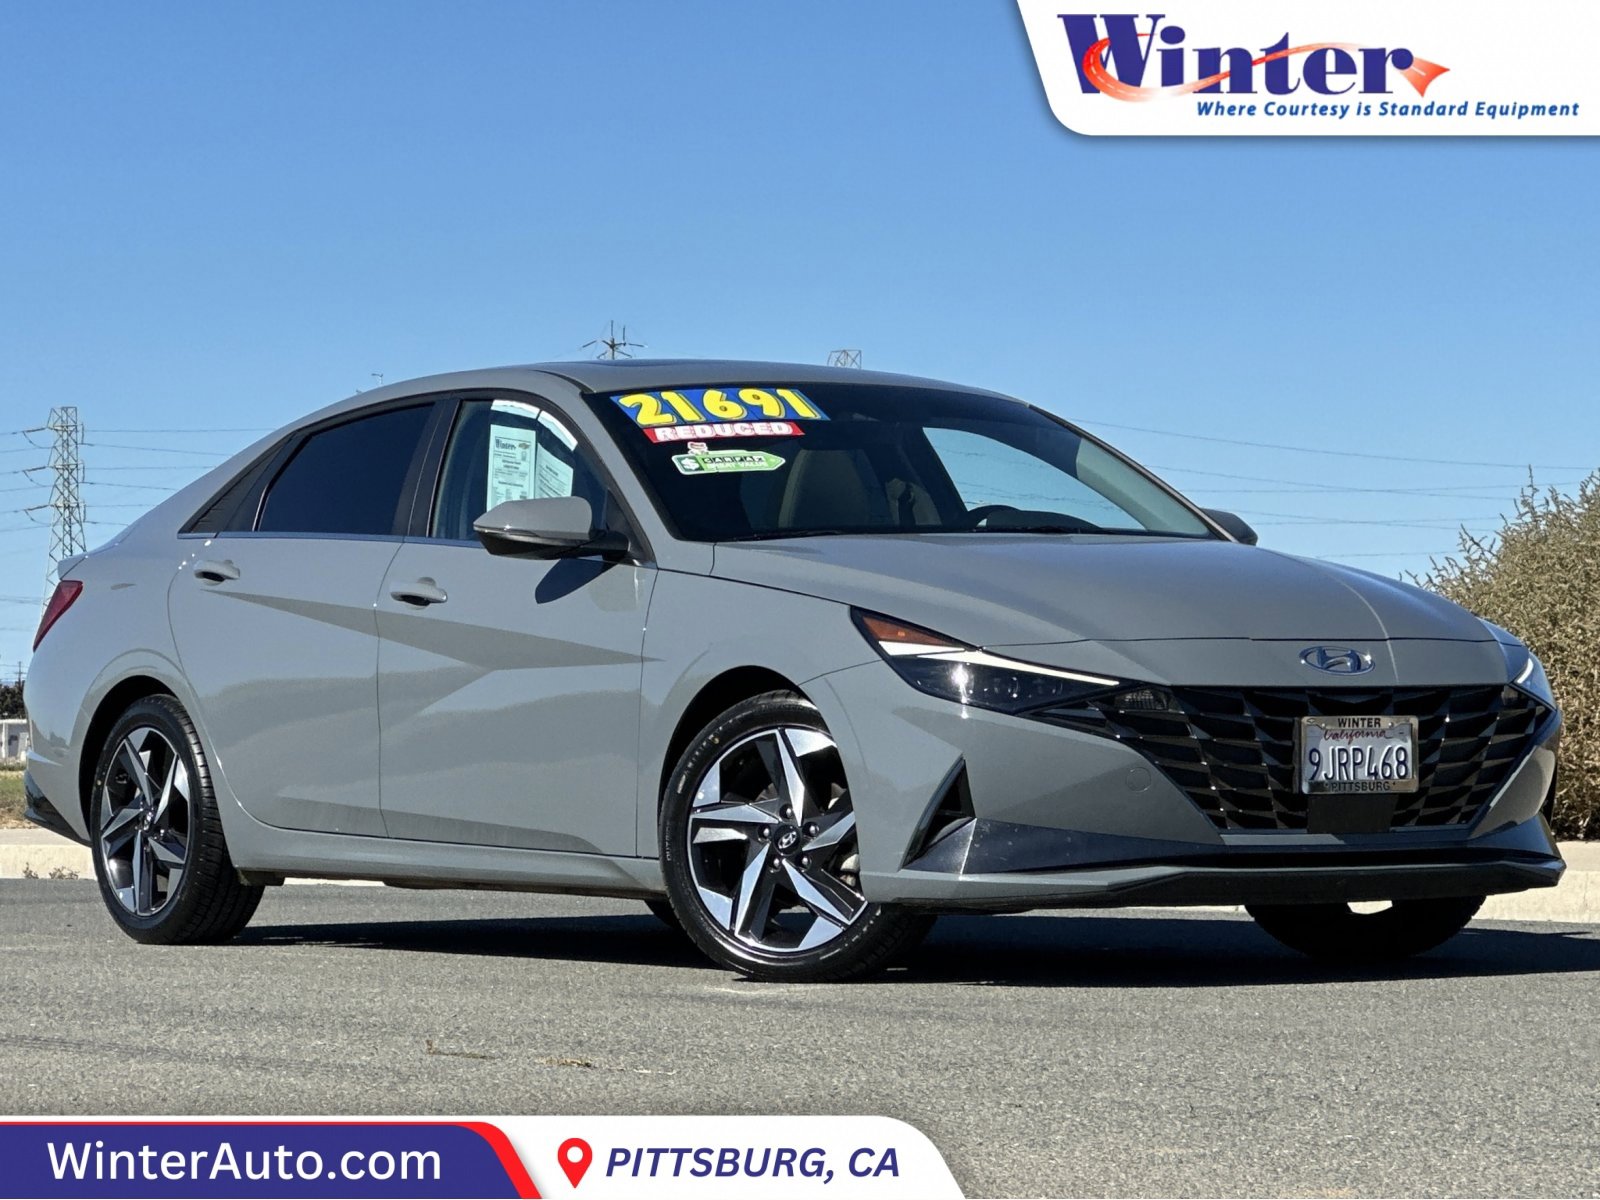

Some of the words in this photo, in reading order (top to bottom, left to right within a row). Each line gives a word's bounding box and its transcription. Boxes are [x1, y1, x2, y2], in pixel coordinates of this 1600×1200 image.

[654, 422, 793, 441] REDUCED
[1337, 717, 1382, 728] WINTER
[1324, 729, 1394, 745] California
[1308, 745, 1409, 780] 9JRP468
[1331, 781, 1391, 791] PITTSBURG
